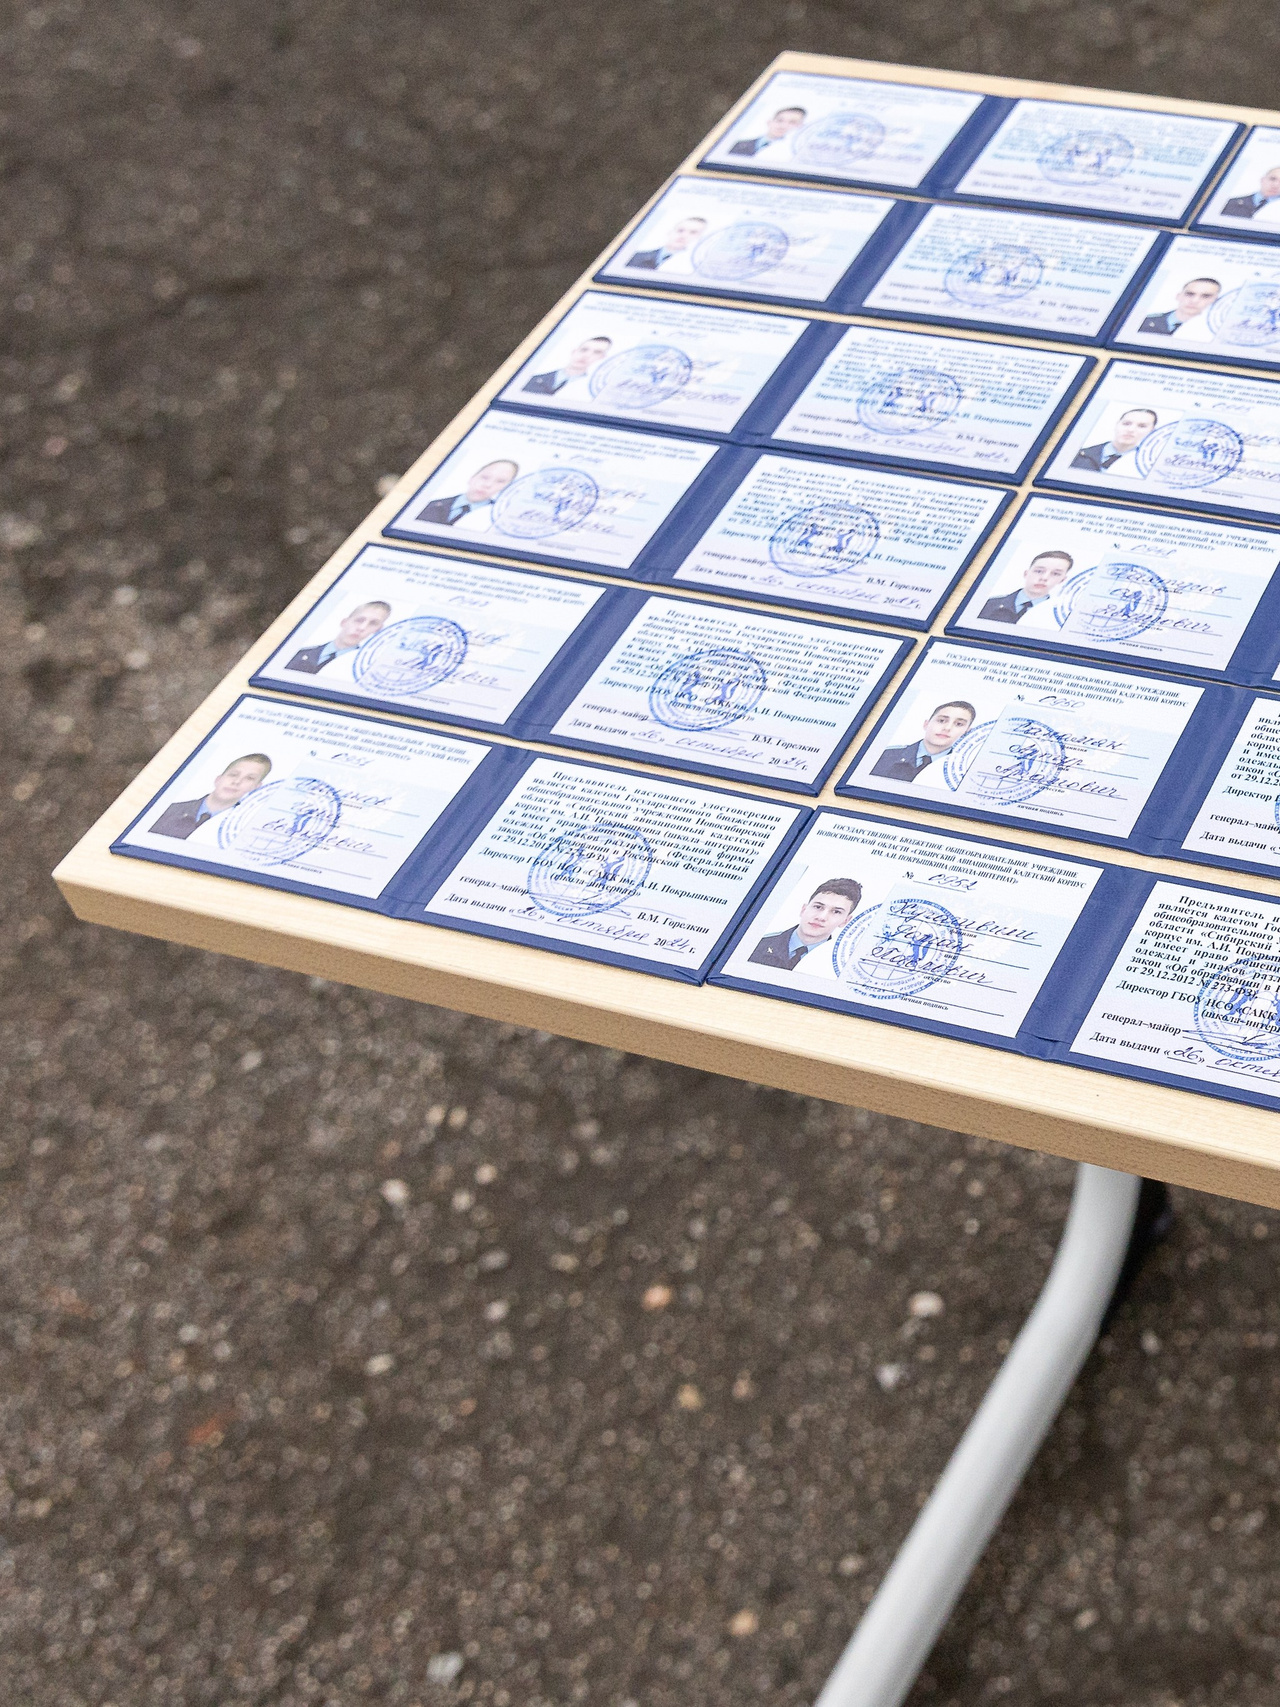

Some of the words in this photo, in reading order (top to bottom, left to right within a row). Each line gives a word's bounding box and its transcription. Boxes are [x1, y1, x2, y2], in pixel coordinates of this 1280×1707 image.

[1157, 902, 1208, 918] является
[1212, 913, 1258, 928] кадетом
[1178, 896, 1266, 920] Предъявитель
[1147, 919, 1195, 935] области
[1199, 929, 1273, 951] «Сибирский
[1152, 910, 1274, 942] общеобразовательного
[1142, 929, 1183, 943] корпус
[1185, 937, 1204, 946] им.
[1206, 940, 1232, 952] А.И.
[1152, 940, 1188, 953] имеет
[1192, 949, 1229, 963] право
[1129, 956, 1162, 968] закон
[1164, 962, 1188, 973] «Об
[1188, 967, 1261, 990] образовании
[1133, 947, 1181, 963] одежды
[1202, 961, 1246, 975] знаков
[1125, 965, 1138, 973] от
[1139, 966, 1195, 985] 29.12.2012
[1115, 980, 1170, 999] Директор
[1088, 1032, 1118, 1046] Дата
[1117, 1039, 1161, 1056] выдачи
